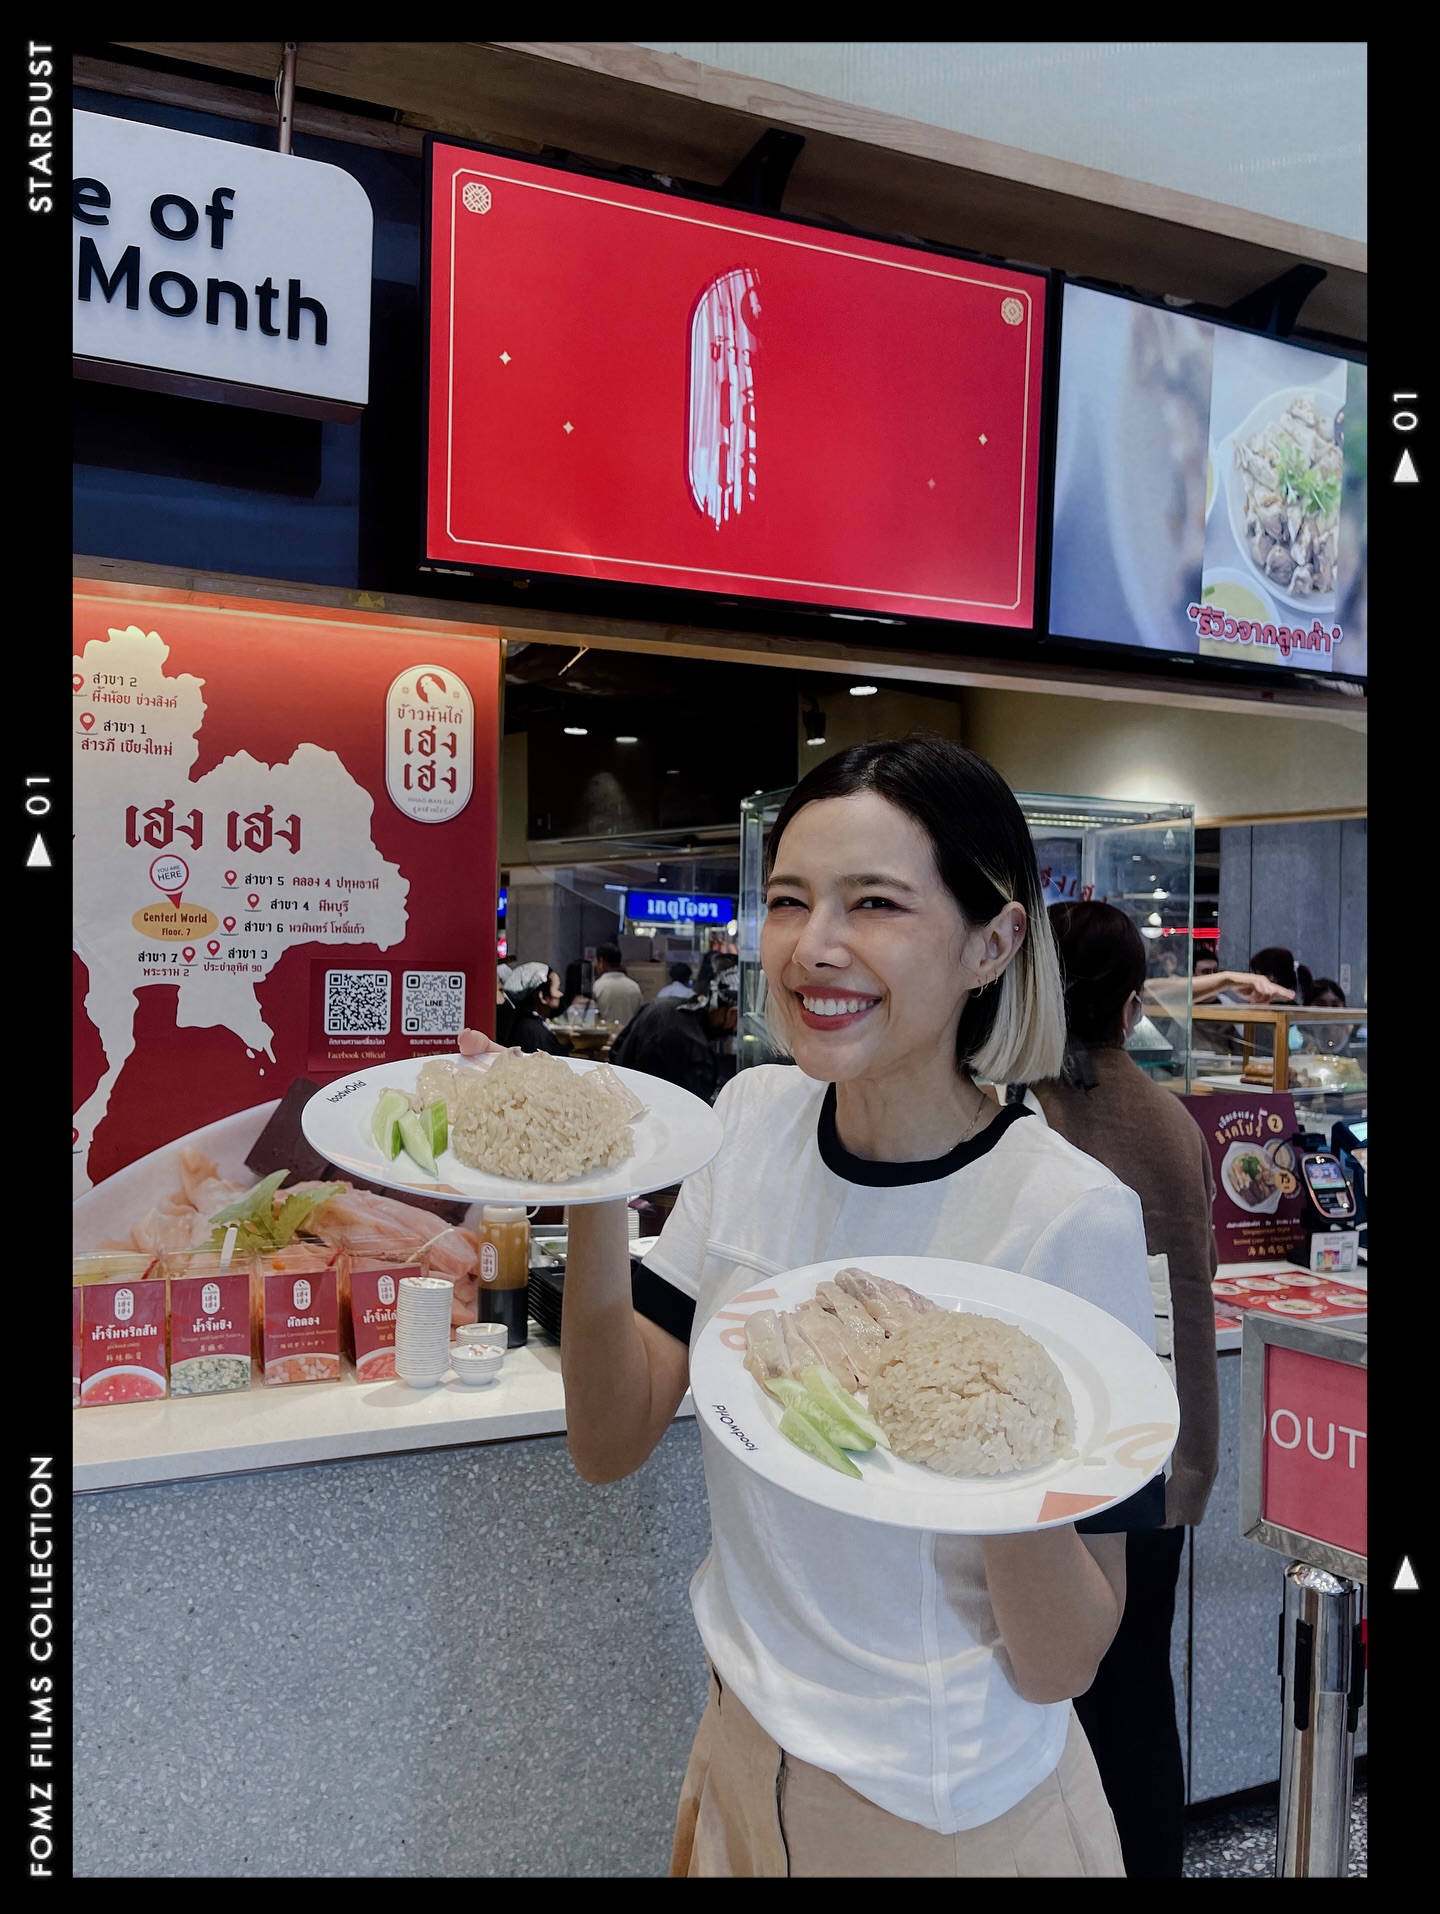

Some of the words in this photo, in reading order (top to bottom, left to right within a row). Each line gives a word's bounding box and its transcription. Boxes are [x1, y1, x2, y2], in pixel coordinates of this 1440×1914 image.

[150, 187, 236, 249] of
[78, 236, 328, 346] Month
[92, 672, 124, 686] สาขา
[129, 677, 138, 687] 2
[397, 703, 464, 725] ข้าวมันไก่
[103, 720, 134, 734] สาขา
[140, 725, 147, 735] 1
[81, 738, 116, 752] สารภี
[121, 738, 173, 756] เชียงใหม่
[404, 725, 457, 759] เฮง
[404, 760, 457, 794] เฮง
[125, 799, 204, 851] เฮง
[226, 804, 302, 855] เฮง
[157, 871, 182, 881] HERE
[244, 874, 273, 885] สาขา
[277, 876, 285, 886] 5
[324, 878, 331, 888] 4
[270, 898, 298, 910] สาขา
[302, 901, 310, 911] 4
[318, 899, 349, 917] มีนบุรี
[180, 913, 208, 924] World
[186, 928, 191, 936] 7
[244, 921, 272, 933] สาขา
[276, 924, 284, 933] 6
[138, 951, 166, 963] สาขา
[171, 953, 178, 963] 7
[228, 947, 256, 960] สาขา
[261, 950, 268, 959] 3
[183, 968, 190, 977] 2
[251, 964, 263, 972] 90
[327, 1051, 359, 1059] Facebook
[361, 1050, 386, 1059] Official
[1271, 1118, 1279, 1130] 2
[712, 1405, 758, 1451] foodwOrld
[1270, 1409, 1367, 1468] OUT
